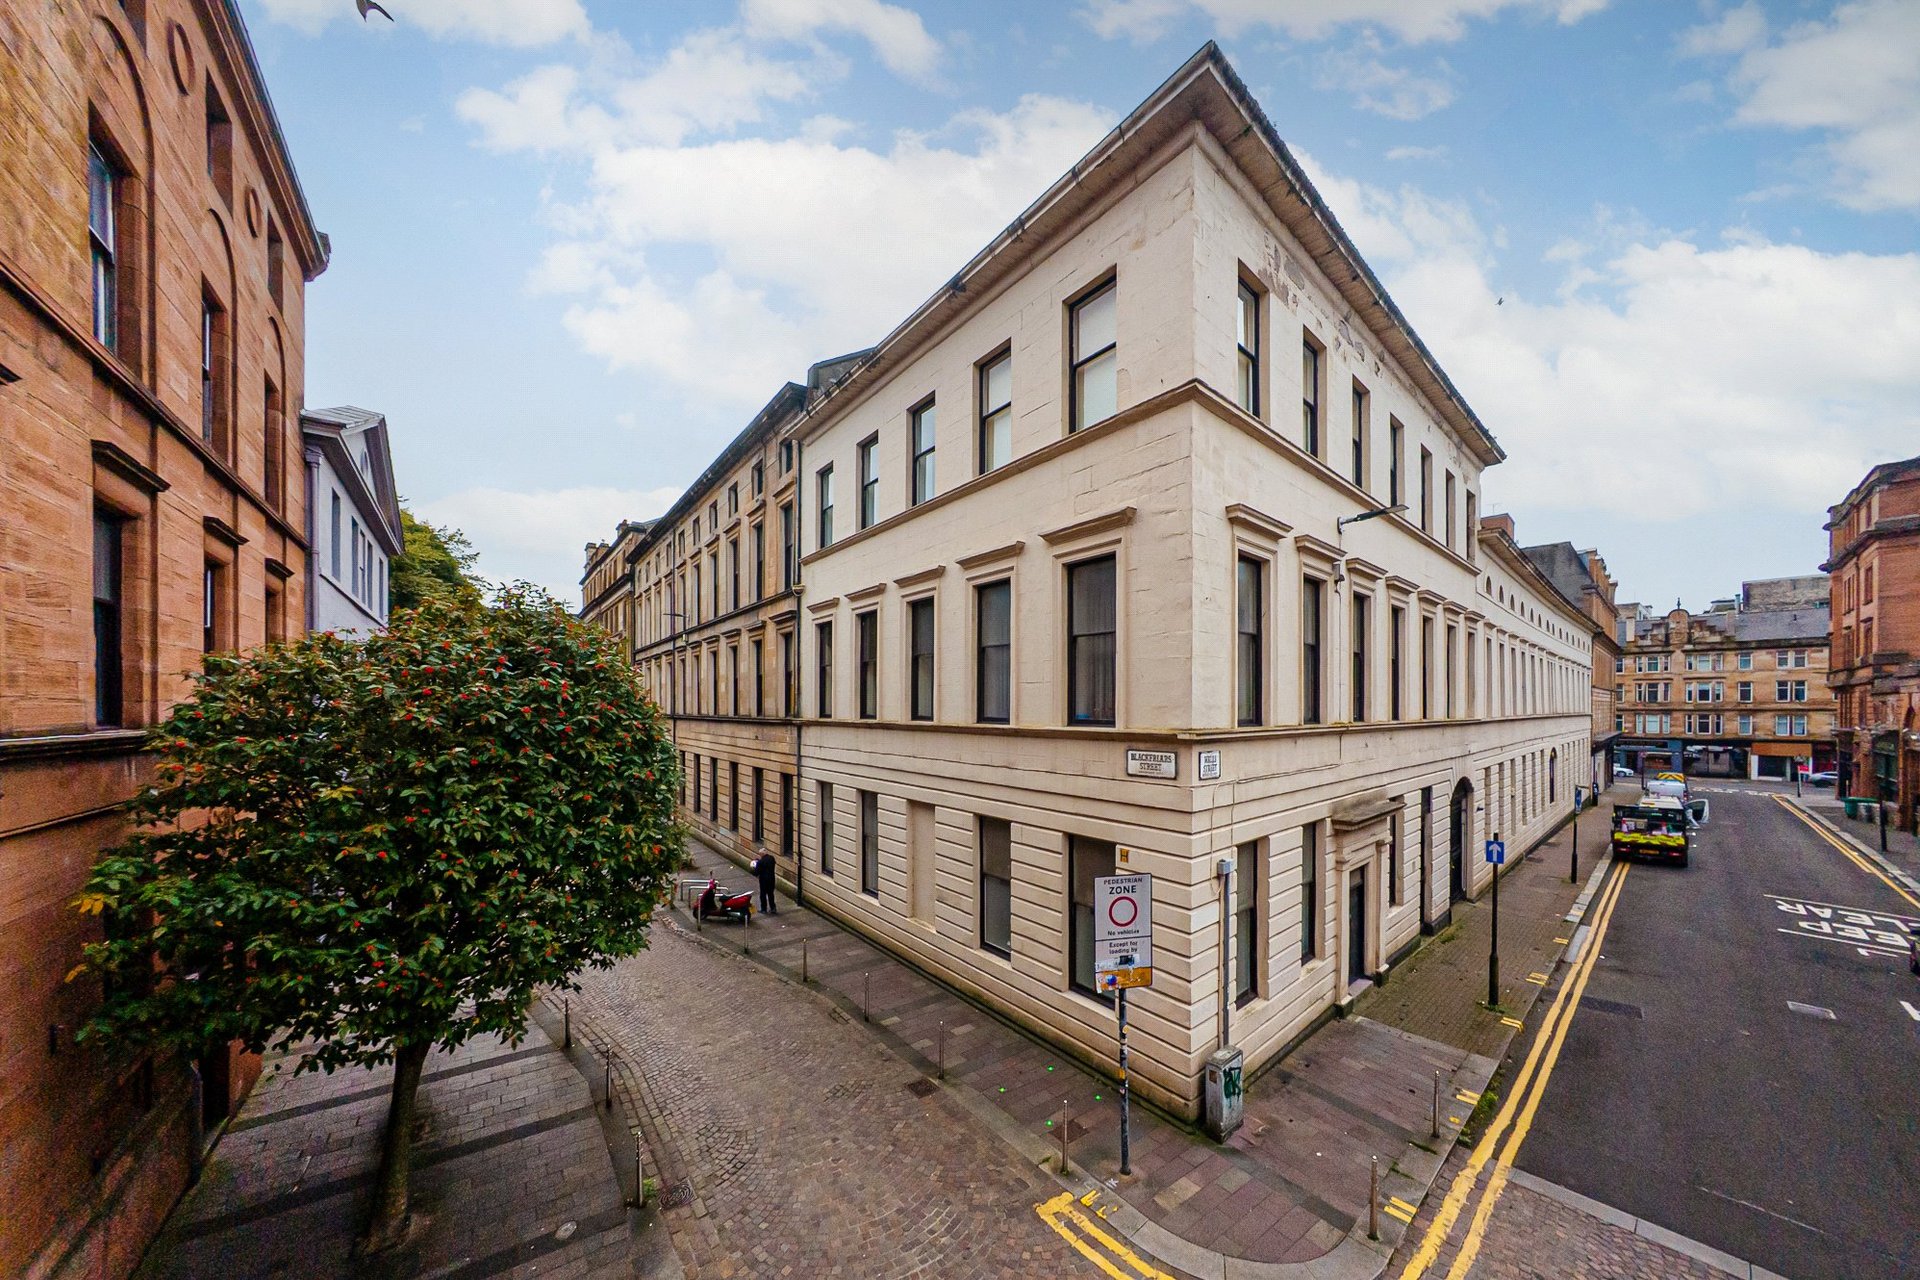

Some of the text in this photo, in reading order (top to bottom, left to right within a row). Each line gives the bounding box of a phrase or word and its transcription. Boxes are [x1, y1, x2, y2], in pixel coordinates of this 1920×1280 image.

[1130, 753, 1172, 763] BLACKFRIARS
[1139, 762, 1162, 771] STREET
[1203, 764, 1218, 772] STREET
[1103, 877, 1143, 885] PEDESTRIAN
[1109, 885, 1137, 895] ZONE
[1799, 921, 1917, 948] EEP
